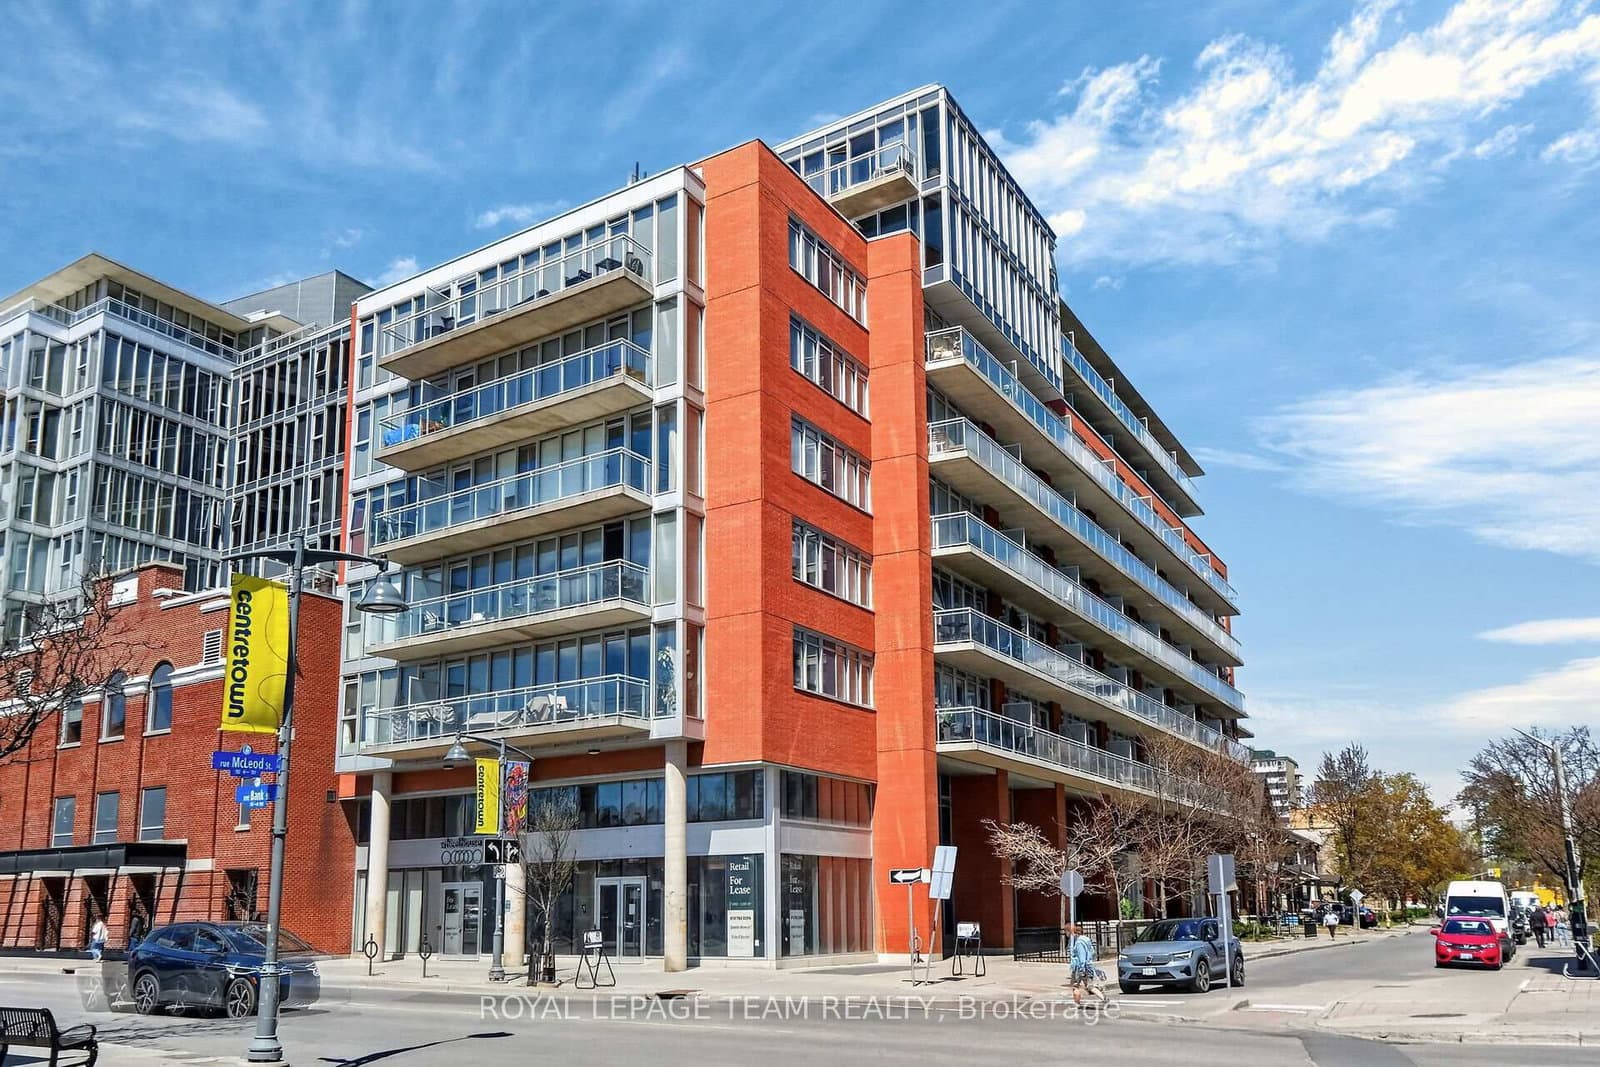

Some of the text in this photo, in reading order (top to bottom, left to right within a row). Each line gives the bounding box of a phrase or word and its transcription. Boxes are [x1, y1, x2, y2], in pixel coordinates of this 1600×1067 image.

[228, 590, 252, 718] centretown
[231, 756, 264, 769] McLeod
[250, 789, 264, 801] Bank
[729, 862, 749, 871] Retail
[729, 876, 743, 885] For
[729, 886, 751, 894] Lease
